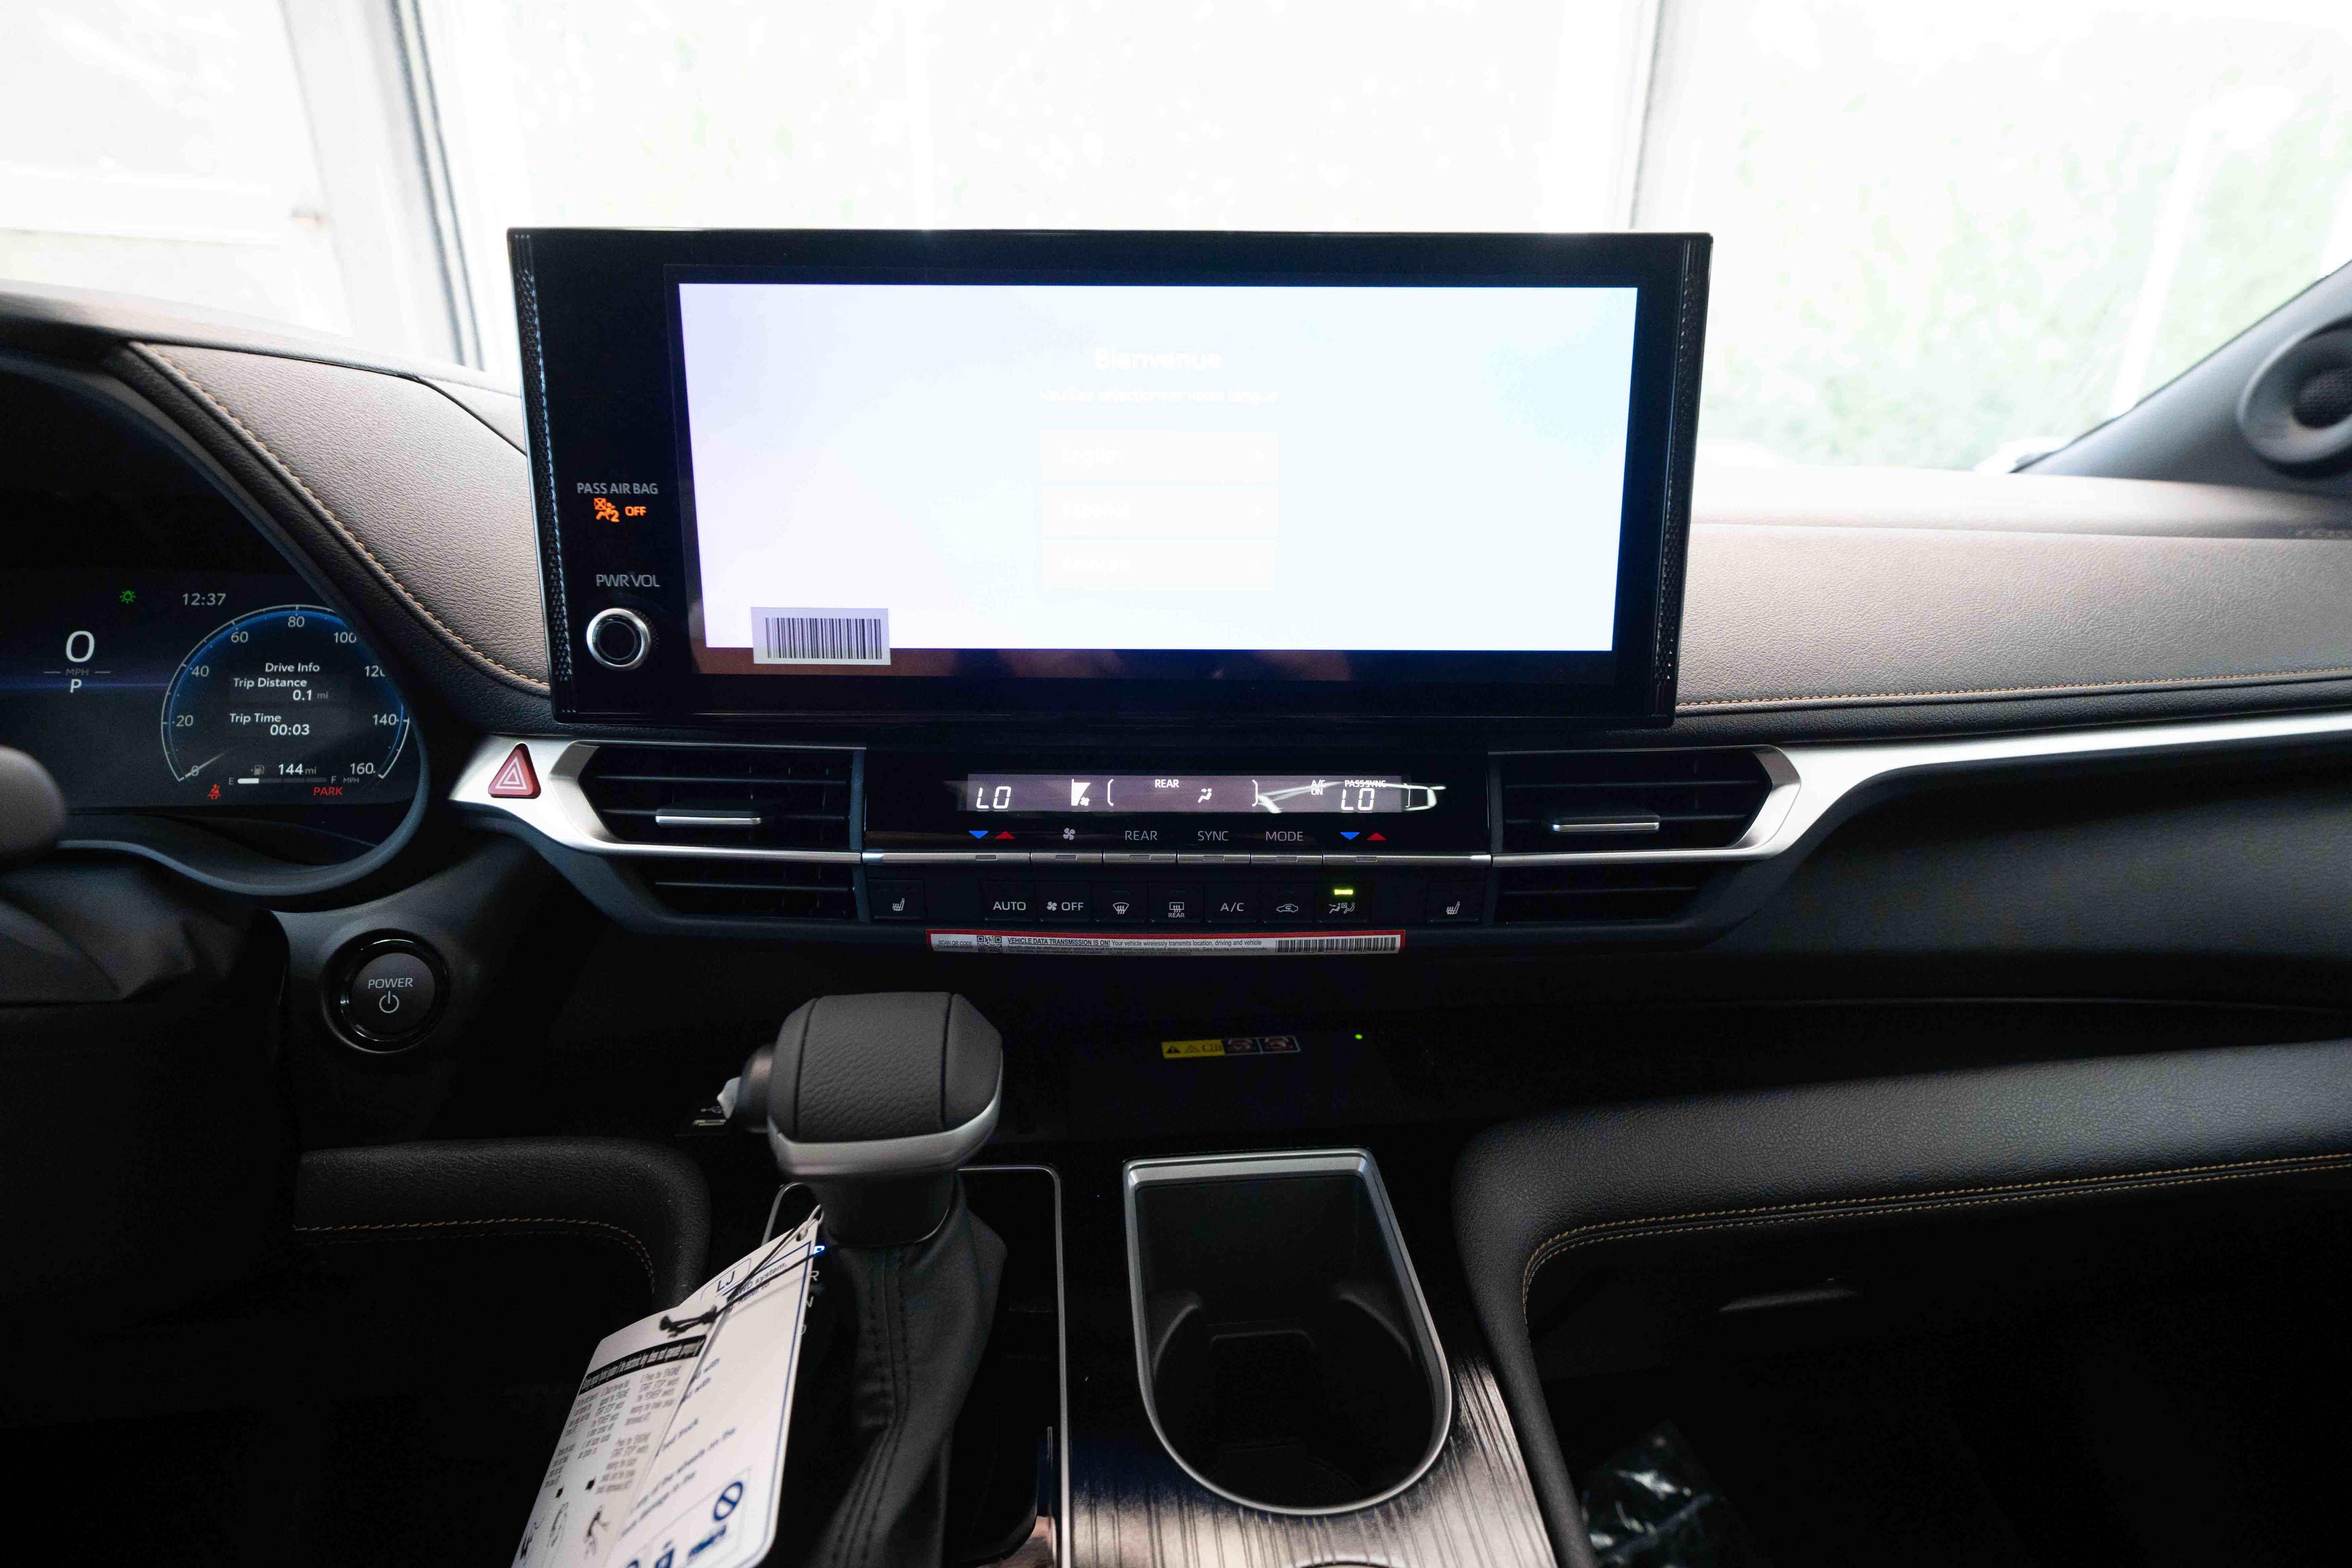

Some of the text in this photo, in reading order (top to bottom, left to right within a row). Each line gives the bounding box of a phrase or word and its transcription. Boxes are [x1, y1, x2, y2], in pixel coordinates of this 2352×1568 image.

[577, 483, 659, 494] PASS AIR BAG
[625, 506, 647, 516] OFF
[596, 575, 661, 587] PWR VOL
[182, 593, 226, 606] 12:37
[287, 617, 305, 628] 80
[231, 632, 248, 643] 60
[333, 632, 356, 644] 100
[192, 666, 209, 677] 40
[265, 662, 320, 672] Drive Info
[70, 678, 82, 693] P
[234, 677, 307, 689] Trip Distance
[292, 689, 329, 701] 0.1 mi
[176, 715, 194, 727] 20
[230, 713, 281, 724] Trip Time
[372, 714, 397, 725] 140
[270, 724, 310, 735] 00:03
[278, 763, 303, 775] 144
[350, 763, 374, 775] 160
[228, 777, 234, 786] E
[1155, 779, 1179, 788] REAR
[1311, 779, 1326, 788] A/C
[313, 786, 343, 796] PARK
[976, 786, 1012, 809] LO
[1341, 788, 1375, 811] LO
[1125, 831, 1158, 841] REAR
[1198, 831, 1229, 841] SYNC
[1266, 831, 1304, 841] MODE
[993, 902, 1026, 911] AUTO
[1061, 902, 1084, 911] OFF
[1220, 902, 1244, 912] A/C
[368, 978, 413, 989] POWER
[717, 1270, 735, 1293] LJ
[809, 1271, 819, 1281] R
